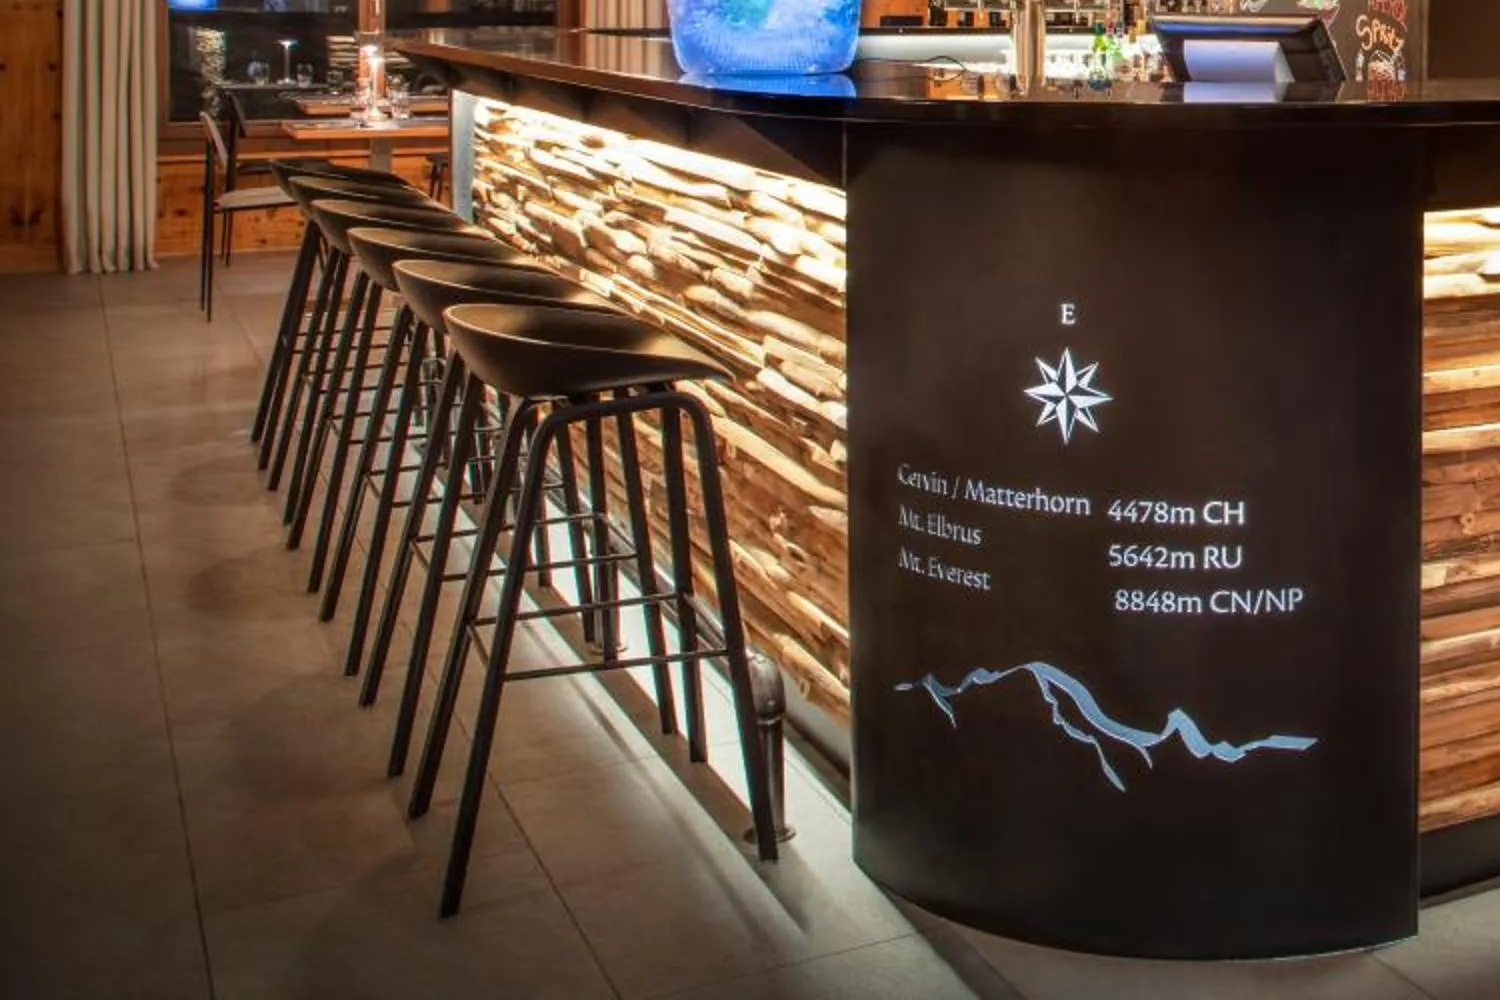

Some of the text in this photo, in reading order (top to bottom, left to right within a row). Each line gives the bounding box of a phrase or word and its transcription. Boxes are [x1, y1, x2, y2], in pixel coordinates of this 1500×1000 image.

[1061, 302, 1076, 325] E
[897, 463, 948, 497] Cervin
[964, 478, 1092, 517] Matterhorn
[1107, 499, 1196, 525] 4478m
[1202, 501, 1245, 526] CH
[927, 510, 984, 546] Elbrus
[1108, 543, 1196, 570] 5642m
[1203, 545, 1243, 570] RU
[927, 555, 991, 591] Everest
[1114, 588, 1202, 614] 8848m
[1208, 587, 1304, 616] CN/NP
